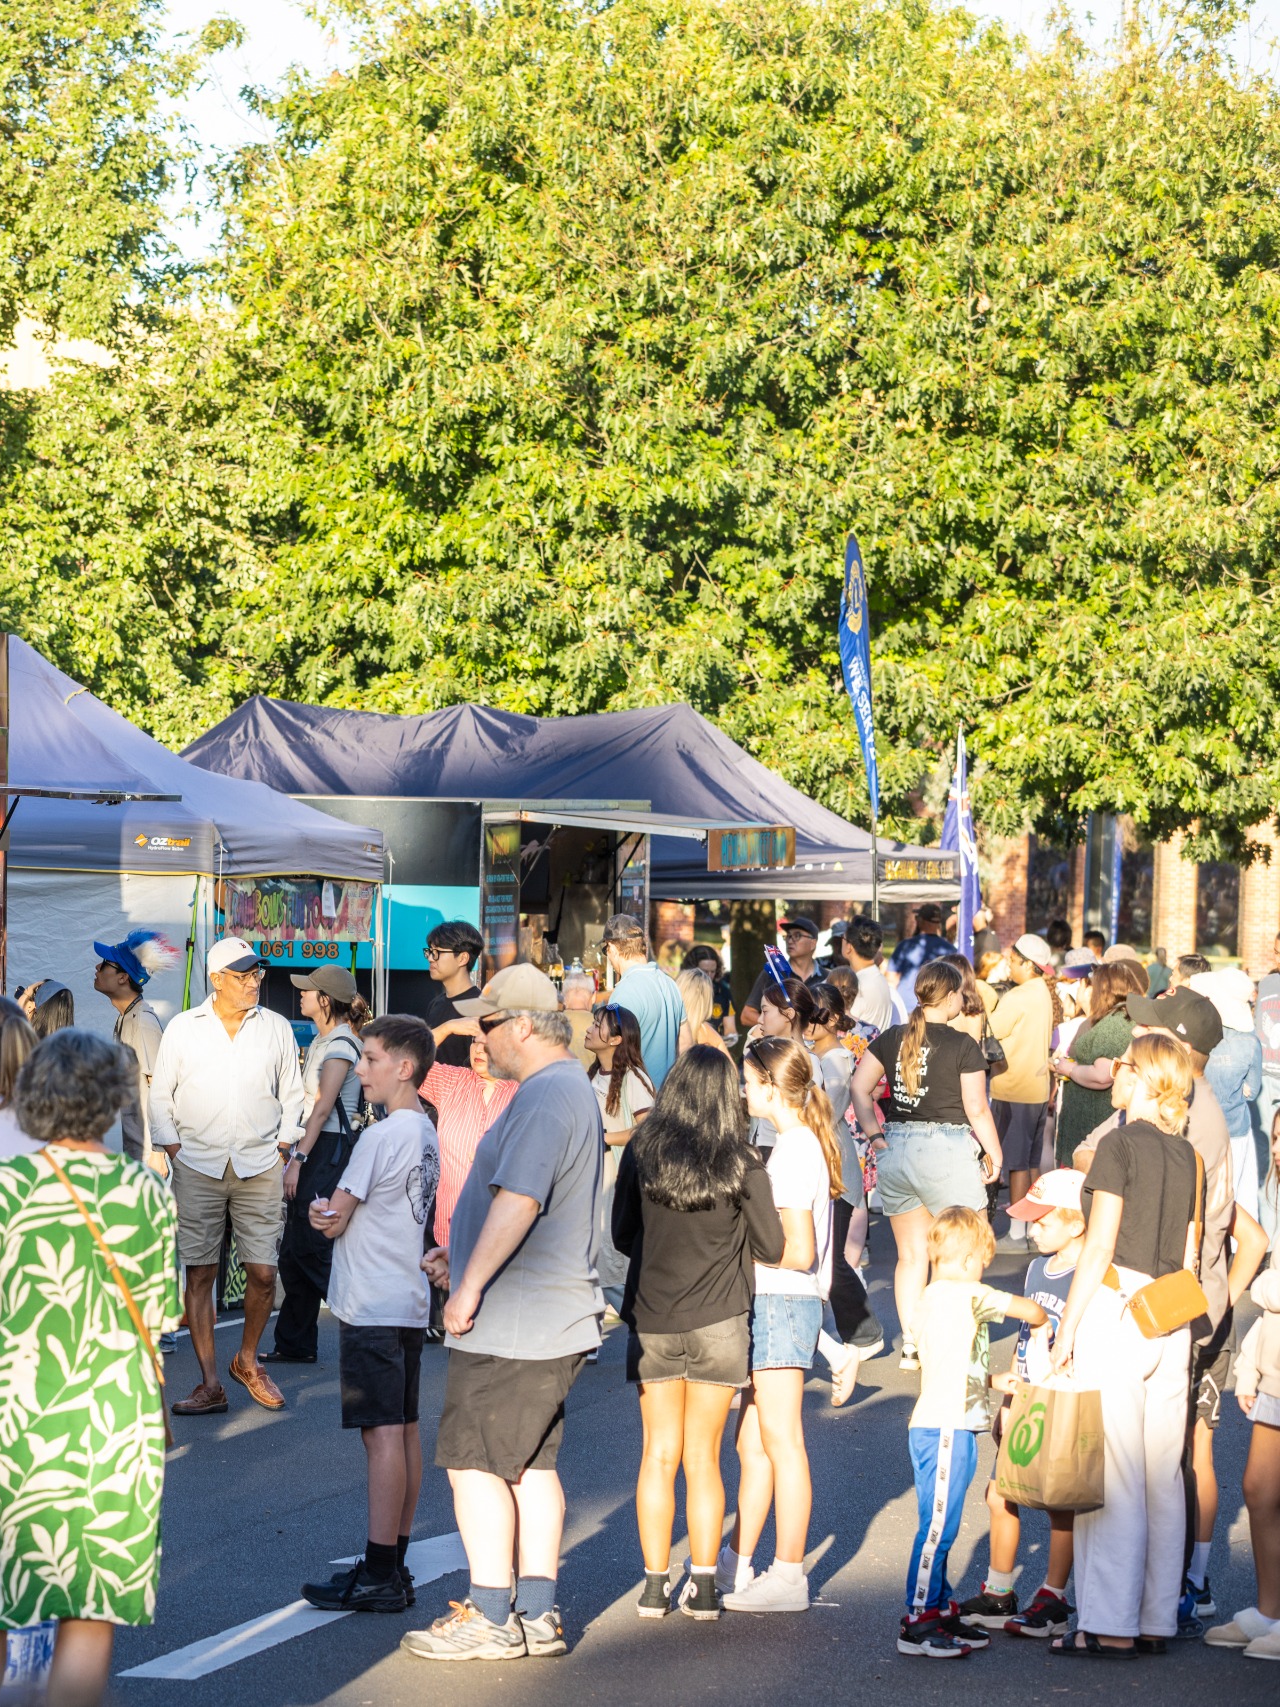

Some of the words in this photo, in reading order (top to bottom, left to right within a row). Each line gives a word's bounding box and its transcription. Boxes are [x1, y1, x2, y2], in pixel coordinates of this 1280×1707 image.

[150, 836, 191, 847] OZtrail
[260, 941, 294, 958] 061
[302, 942, 339, 959] 998
[893, 1082, 929, 1097] Jeus'
[893, 1092, 921, 1108] story
